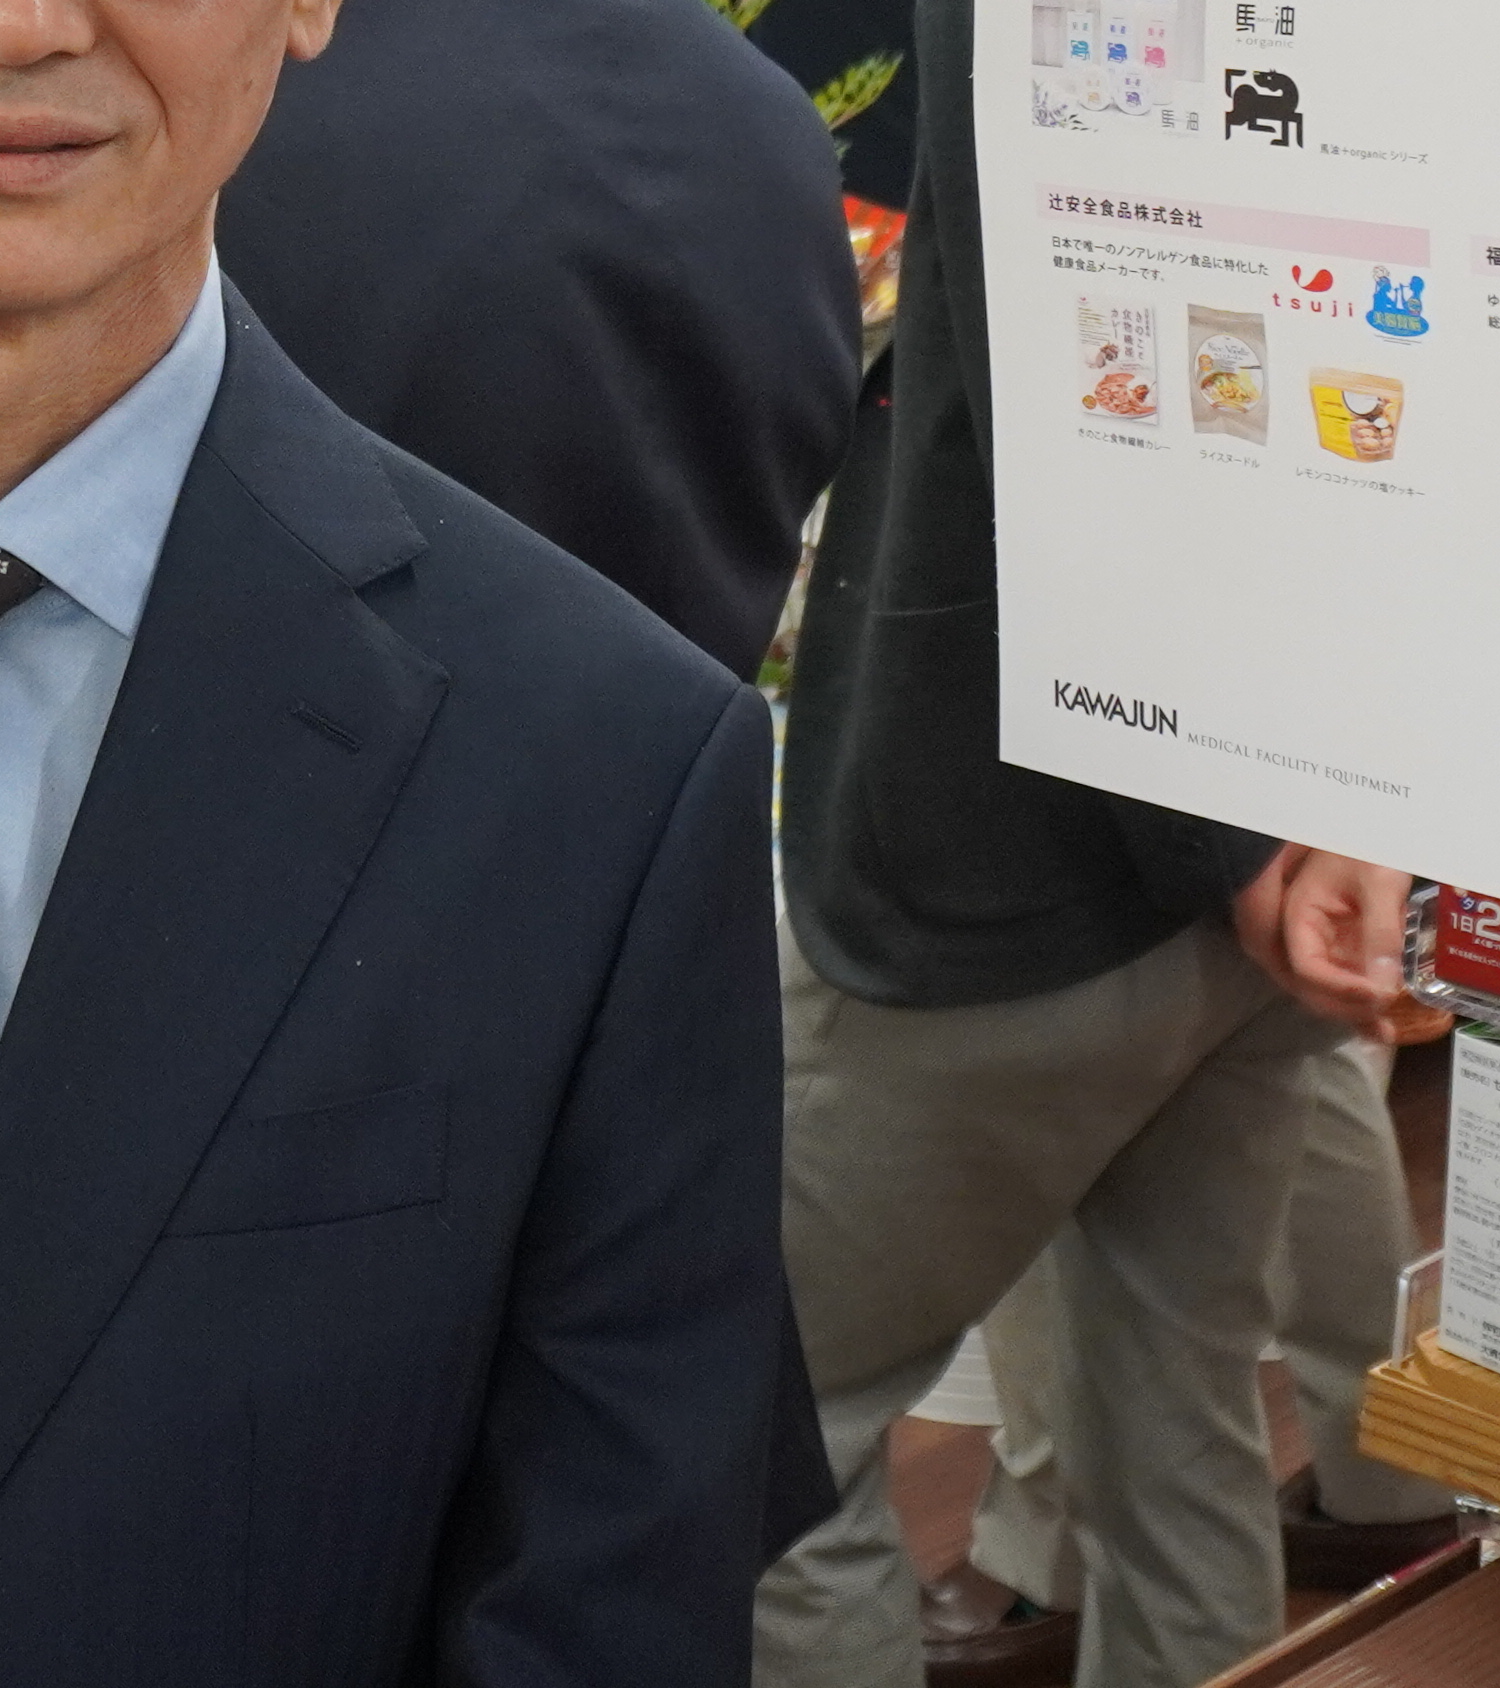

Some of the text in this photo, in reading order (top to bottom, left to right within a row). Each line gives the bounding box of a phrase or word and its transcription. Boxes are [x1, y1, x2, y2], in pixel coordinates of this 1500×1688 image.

[1245, 36, 1295, 50] organic
[1048, 192, 1204, 229] 辻安全食品株式会社
[1272, 291, 1355, 318] tsuji
[1054, 679, 1412, 799] KAWAJUN MEDICAL FACILITY EQUIPMENT
